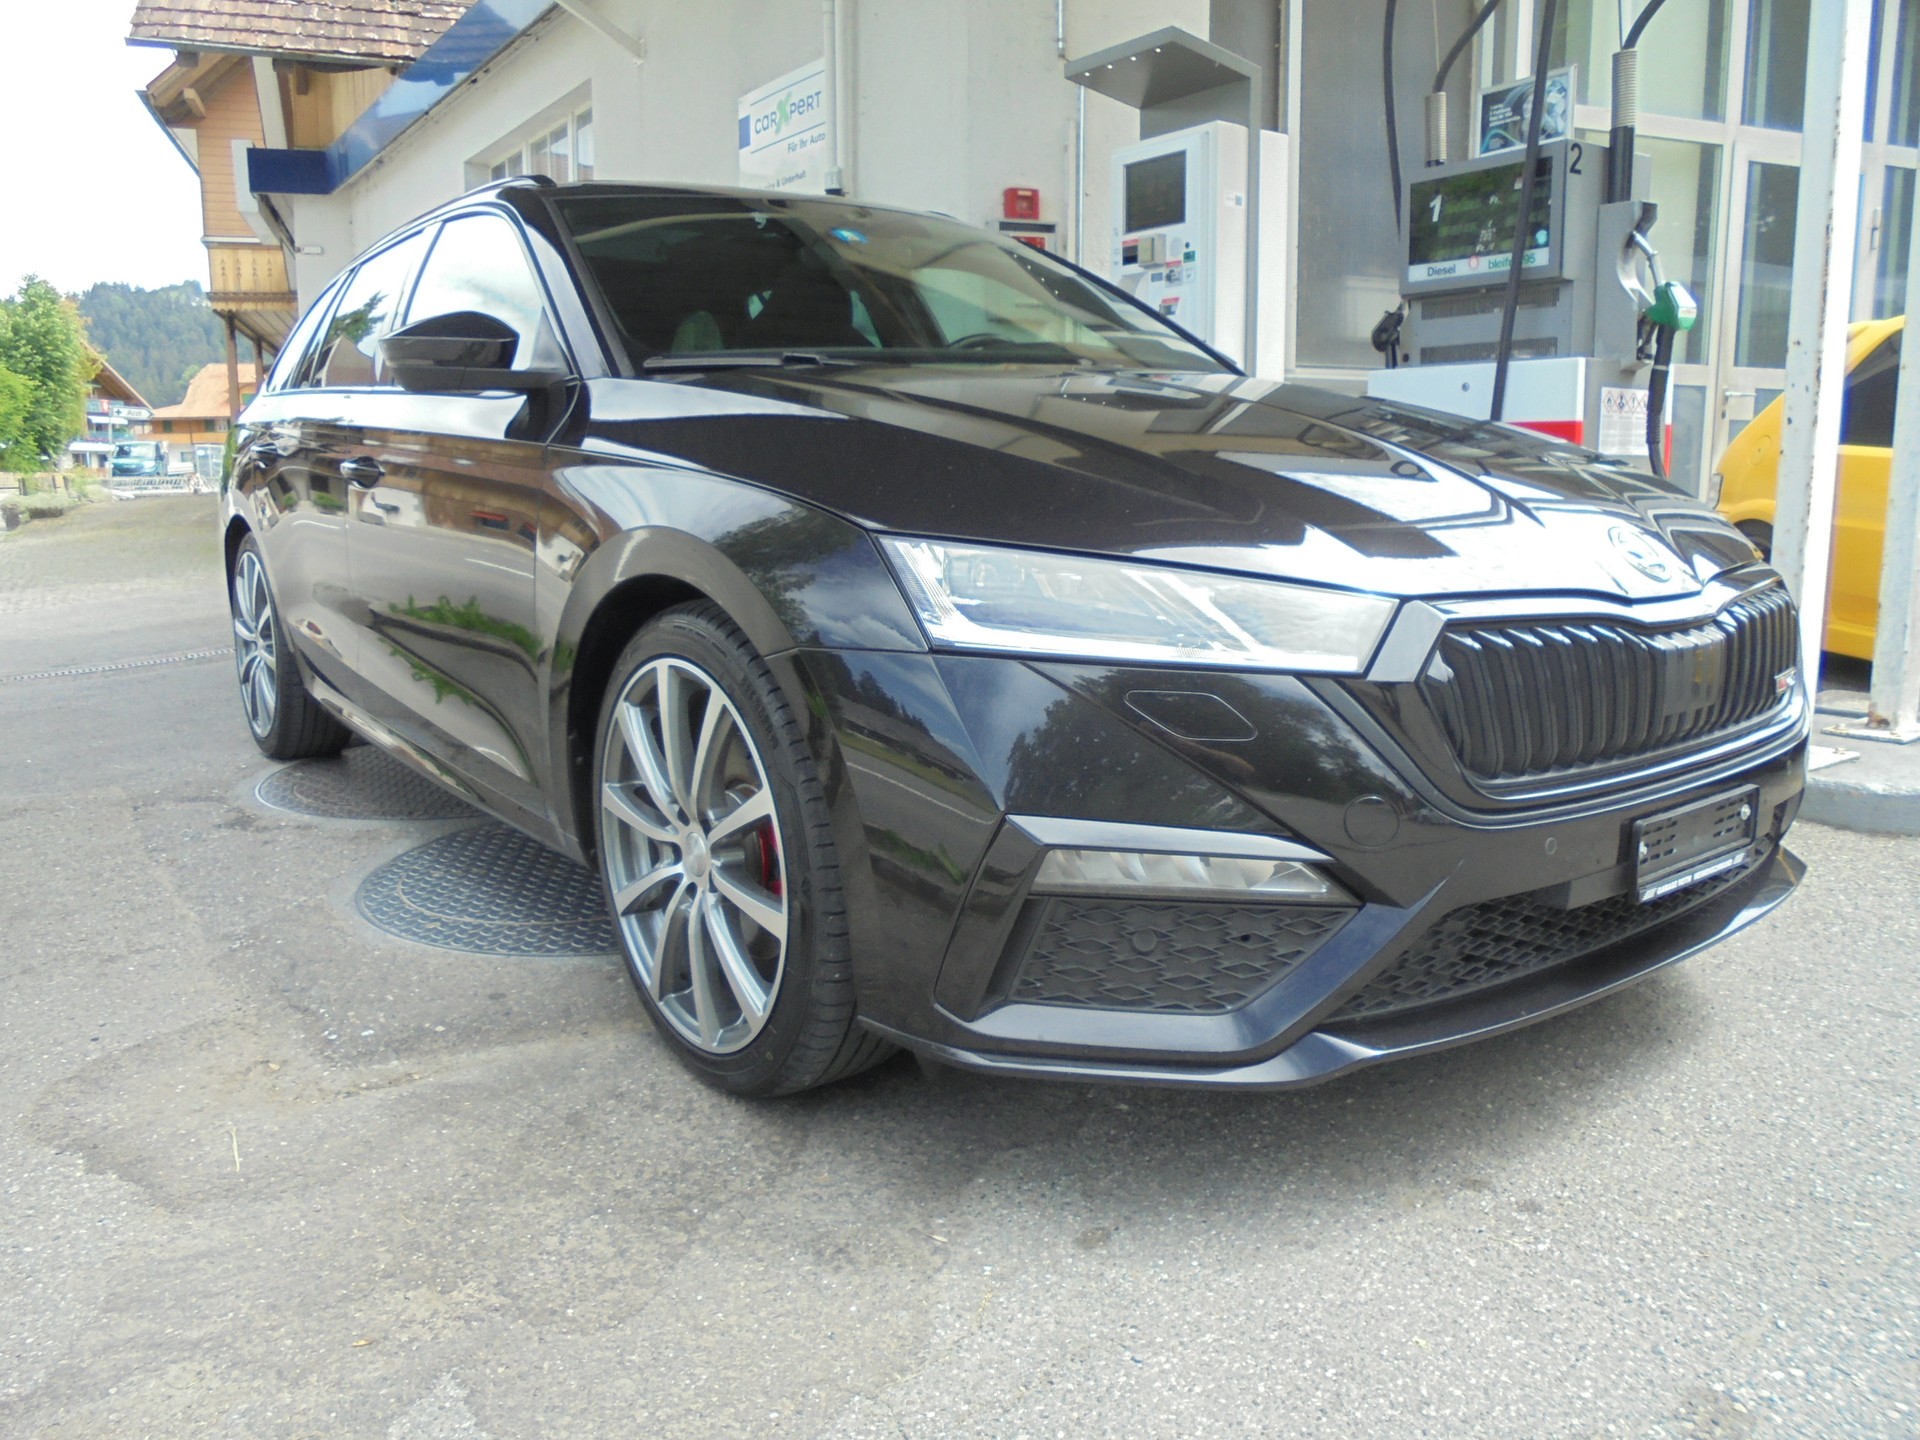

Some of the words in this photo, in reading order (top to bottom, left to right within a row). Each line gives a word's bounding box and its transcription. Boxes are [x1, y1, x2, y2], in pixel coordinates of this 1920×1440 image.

[787, 142, 797, 154] Für
[799, 138, 808, 149] Ihr
[810, 132, 825, 145] Auto
[1569, 143, 1582, 175] 2
[782, 169, 806, 186] Unterhalt
[1429, 194, 1442, 222] 1
[1427, 265, 1456, 277] Diesel
[1523, 253, 1536, 265] 95
